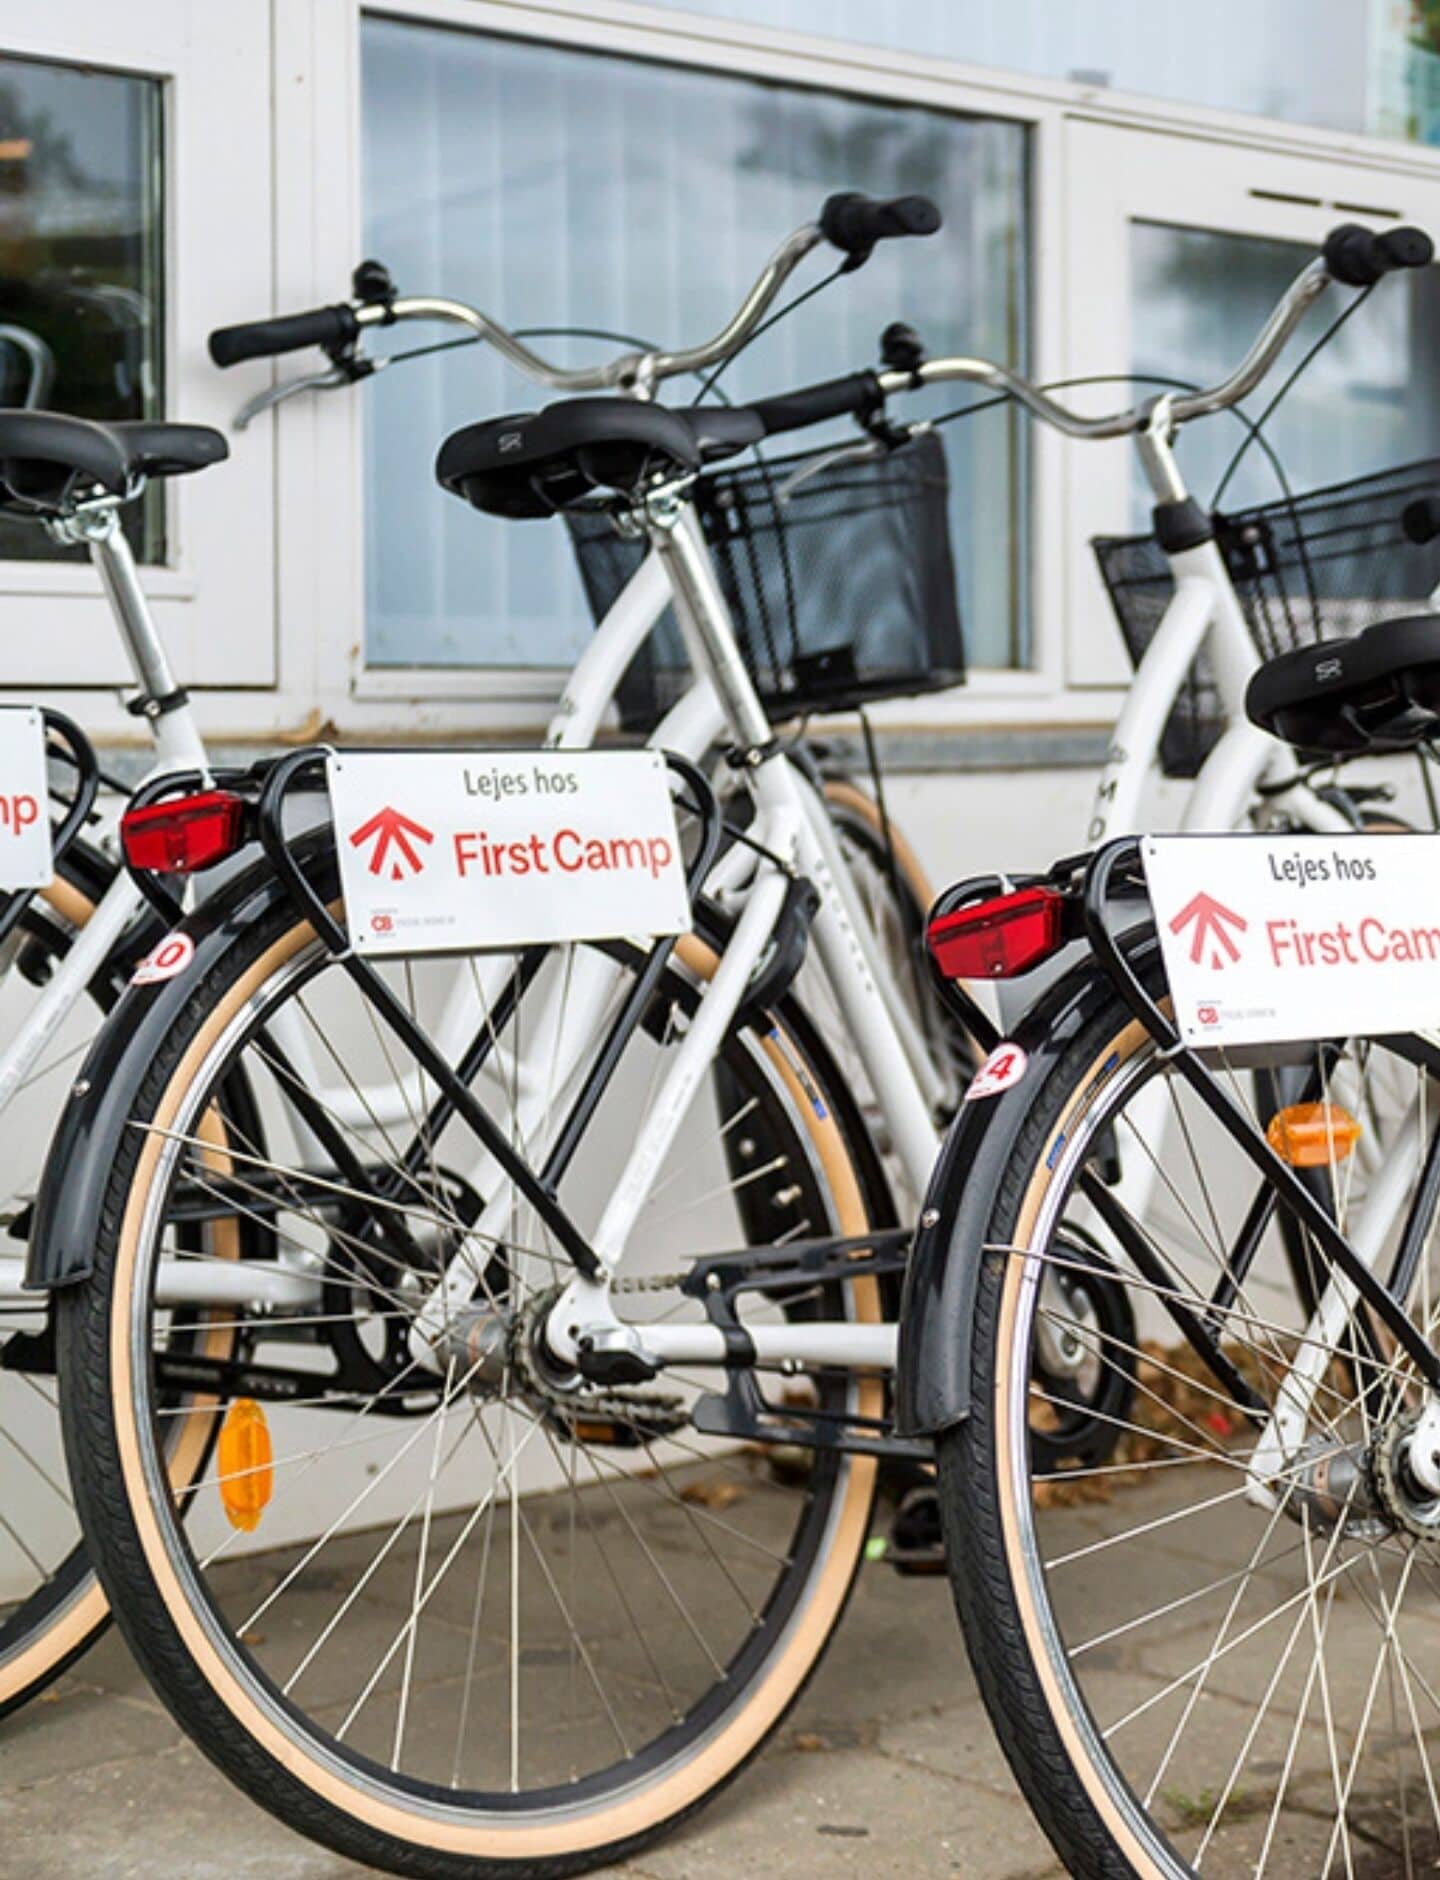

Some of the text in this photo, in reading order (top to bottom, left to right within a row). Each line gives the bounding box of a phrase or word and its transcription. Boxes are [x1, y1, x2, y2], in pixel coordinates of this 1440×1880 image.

[464, 767, 579, 801] Lejes hos
[1268, 851, 1377, 888] Lejes hos
